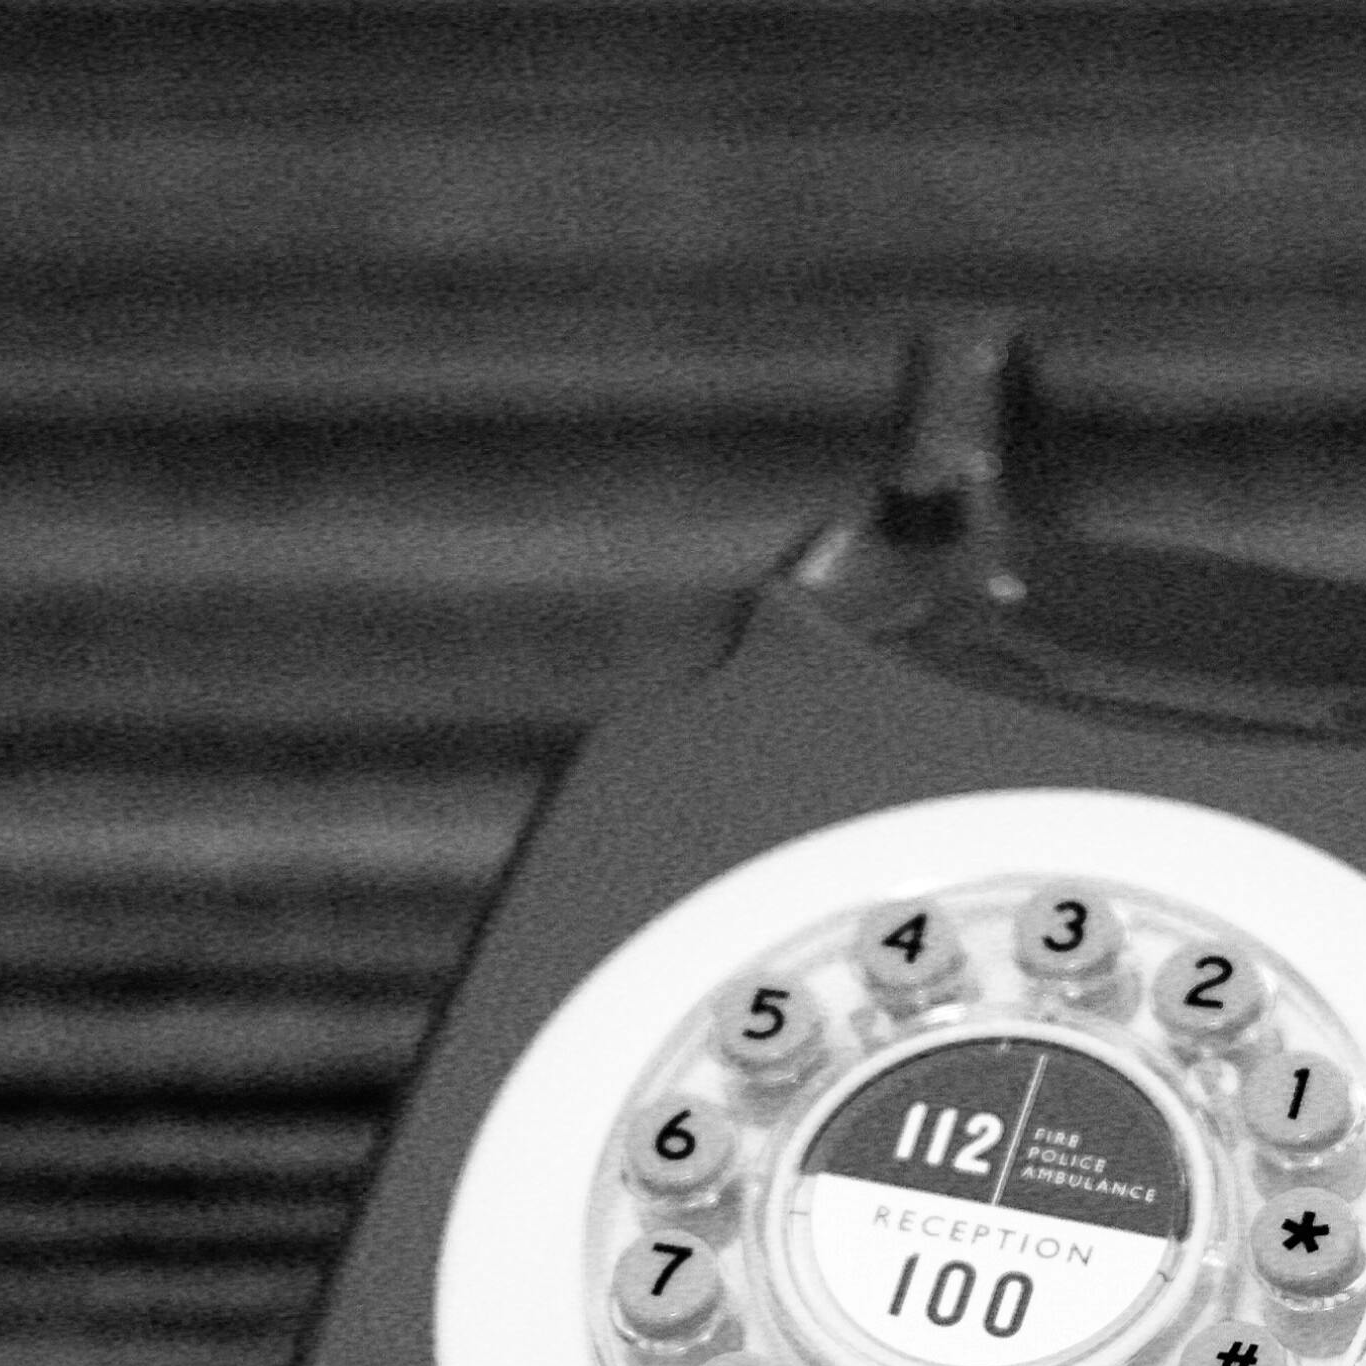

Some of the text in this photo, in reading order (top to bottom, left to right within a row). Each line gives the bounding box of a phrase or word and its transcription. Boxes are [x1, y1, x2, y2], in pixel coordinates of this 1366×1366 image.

[880, 912, 929, 965] 4
[1041, 899, 1089, 954] 3
[1182, 954, 1235, 1011] 2
[741, 986, 791, 1042] 5
[1286, 1066, 1312, 1122] 1
[653, 1108, 697, 1162] 6
[895, 1101, 1005, 1175] 112
[1027, 1145, 1107, 1174] POLICE
[1034, 1127, 1080, 1149] FIRE
[1020, 1165, 1157, 1203] AMBULANCE
[872, 1205, 1095, 1267] RECEPTION
[649, 1241, 695, 1298] 7
[888, 1252, 1034, 1338] 100
